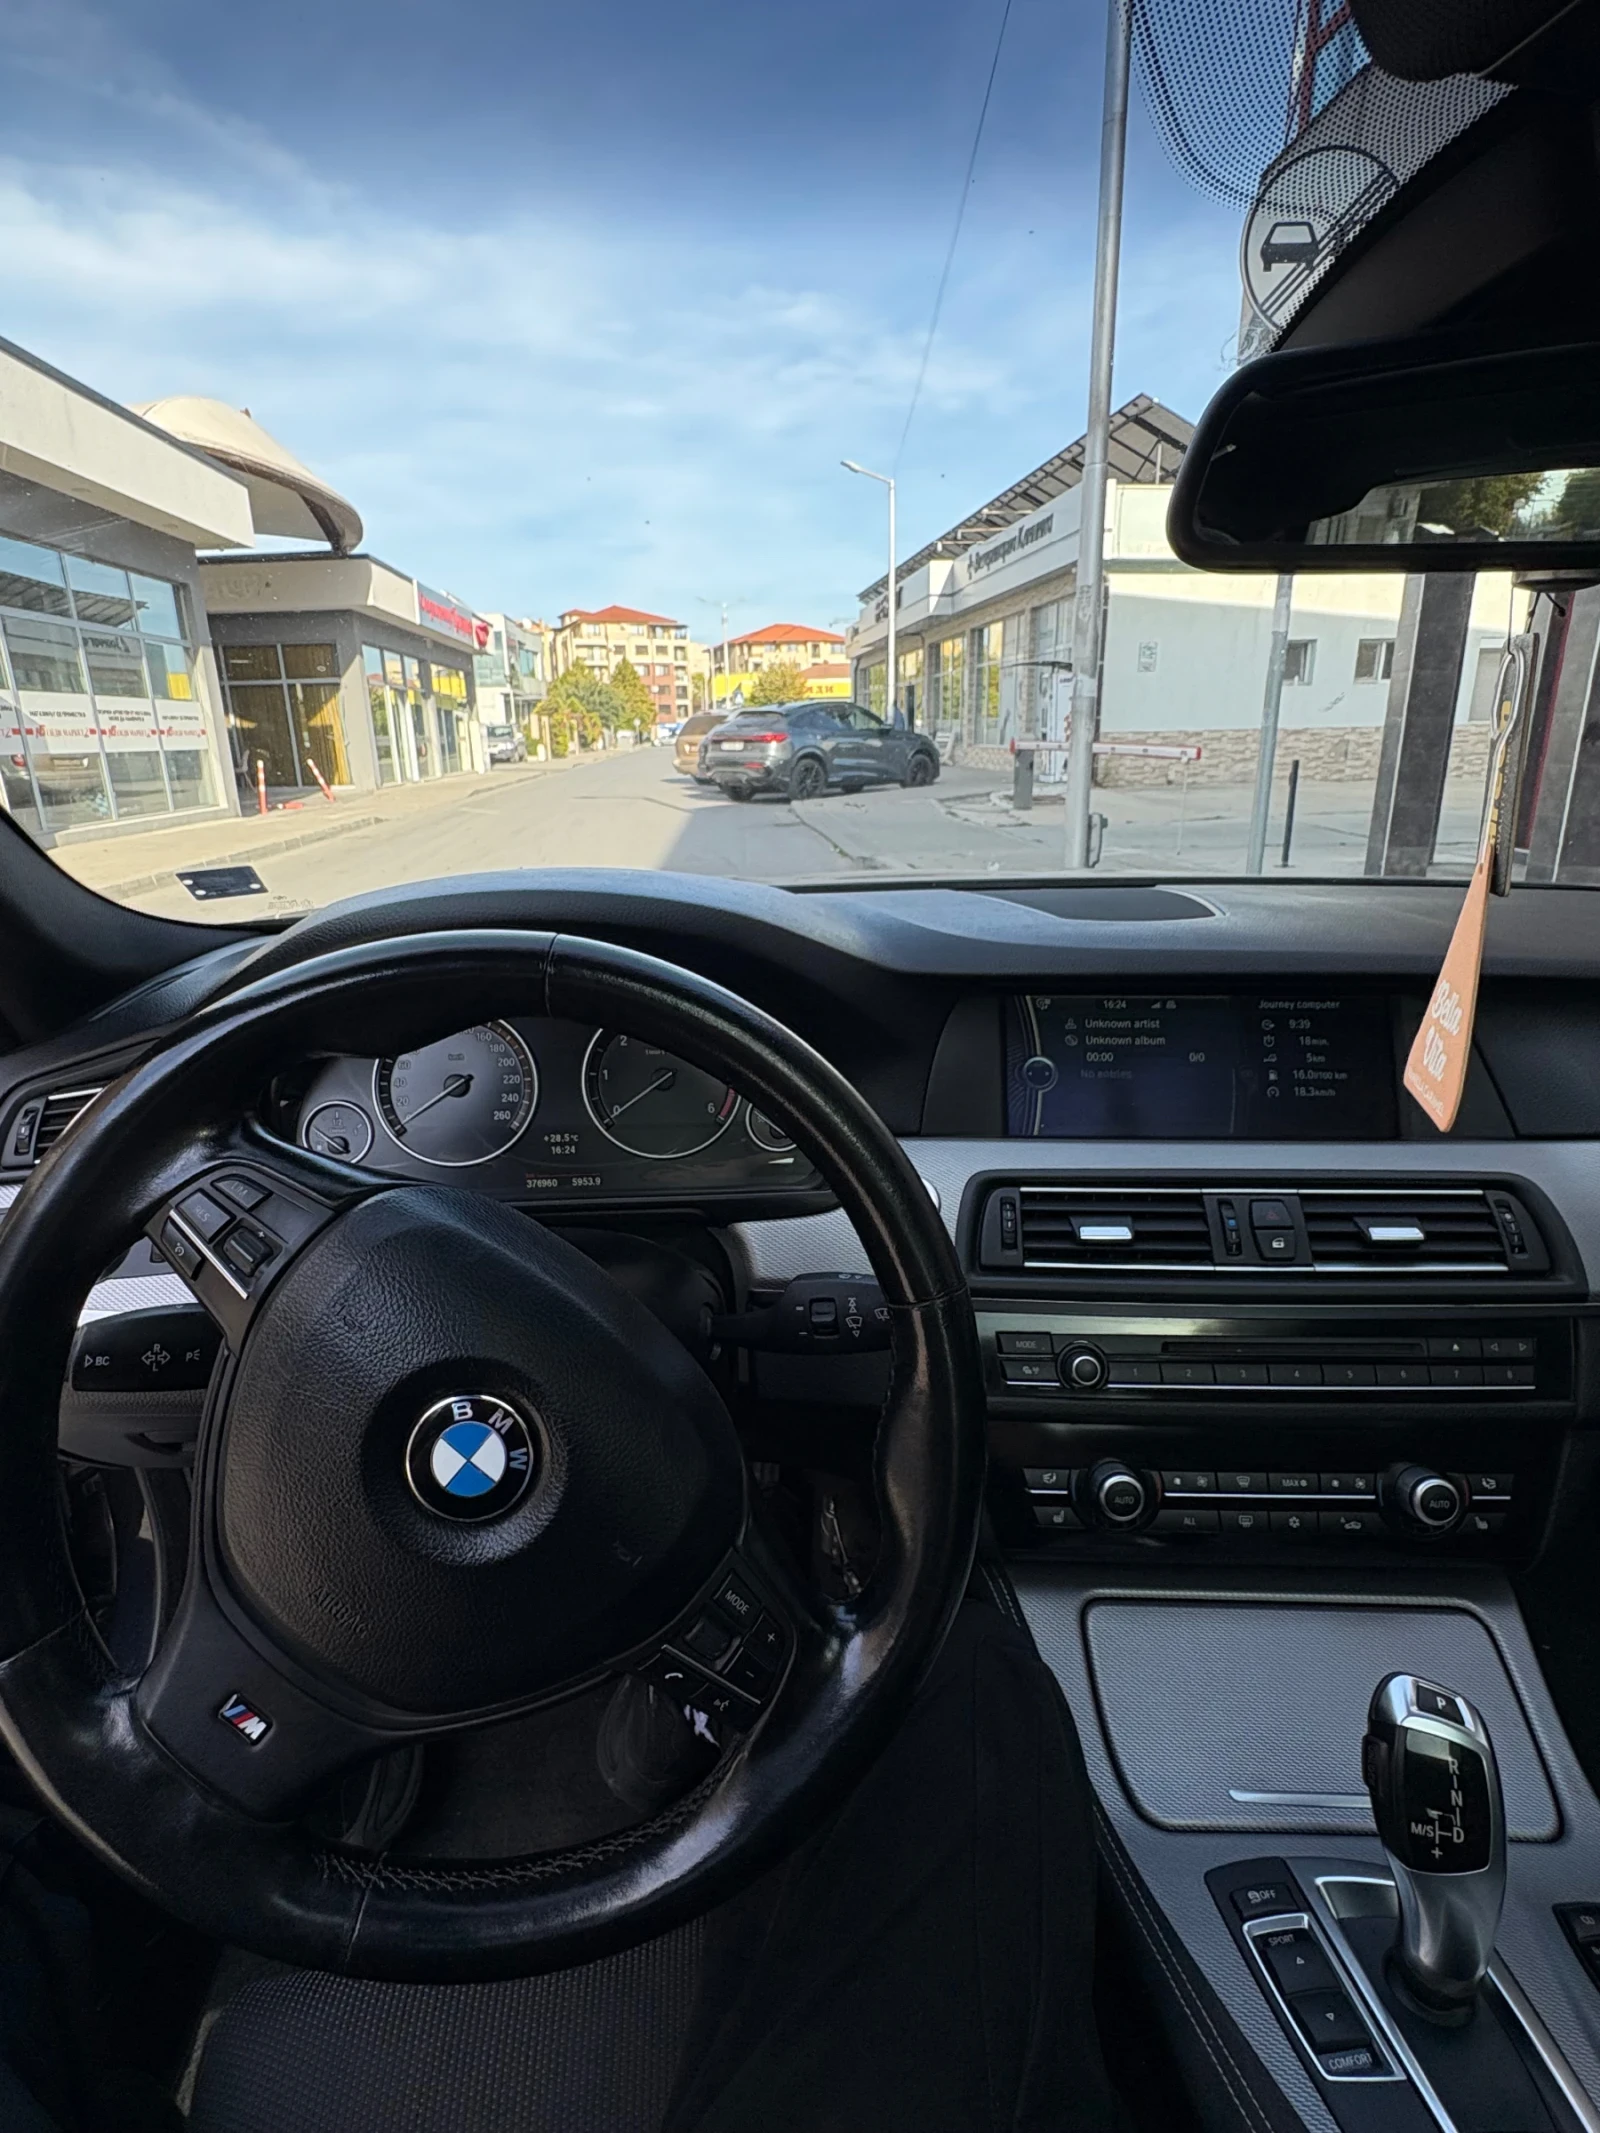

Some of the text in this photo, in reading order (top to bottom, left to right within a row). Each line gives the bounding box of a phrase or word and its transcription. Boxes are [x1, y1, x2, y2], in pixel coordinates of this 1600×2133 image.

[1103, 1000, 1127, 1009] 16:24
[1258, 1000, 1340, 1011] Journey computer
[1431, 979, 1463, 1036] Bella
[1085, 1019, 1160, 1029] Unknown artist
[476, 1033, 492, 1042] 160
[620, 1035, 628, 1046] 2
[1085, 1036, 1166, 1046] Unknown album
[489, 1044, 505, 1053] 180
[1423, 1025, 1447, 1081] Vita
[498, 1058, 515, 1067] 200
[1086, 1052, 1205, 1063] 00:00 0/0
[503, 1075, 521, 1084] 220
[603, 1070, 609, 1080] 1
[397, 1096, 409, 1106] 20
[501, 1094, 519, 1103] 240
[707, 1103, 715, 1113] 6
[493, 1111, 511, 1120] 260
[551, 1146, 576, 1155] 16:24
[572, 1177, 601, 1186] 5953.9
[153, 1343, 160, 1353] R
[1016, 1341, 1038, 1349] MODE
[95, 1356, 110, 1366] BC
[153, 1363, 159, 1372] L
[452, 1401, 527, 1471] BMW
[1282, 1479, 1299, 1488] MAX
[1114, 1496, 1134, 1505] AUTO
[1429, 1500, 1450, 1509] AUTO
[1183, 1517, 1196, 1526] ALL
[725, 1590, 750, 1615] MODE
[1436, 1696, 1446, 1709] P
[1449, 1758, 1460, 1775] R
[1450, 1790, 1463, 1807] N
[1411, 1821, 1464, 1843] M/S D
[1260, 1889, 1277, 1899] OFF
[1268, 1934, 1295, 1947] SPORT
[1328, 2052, 1373, 2071] COMFORT
